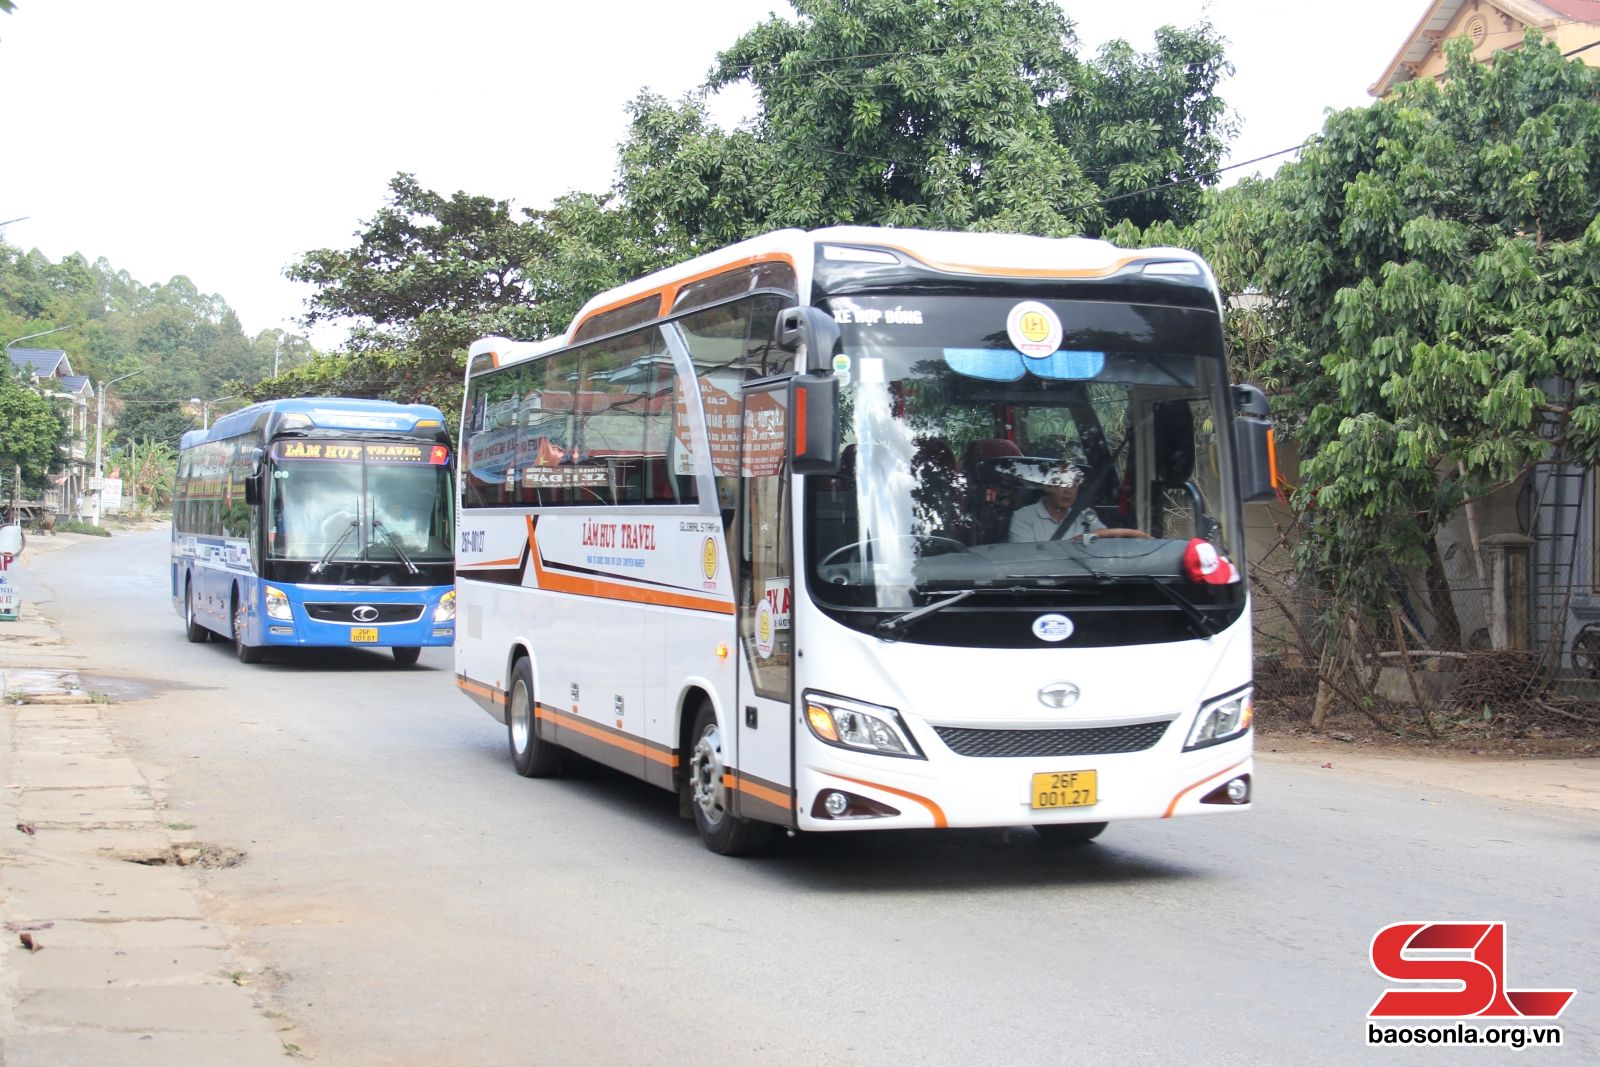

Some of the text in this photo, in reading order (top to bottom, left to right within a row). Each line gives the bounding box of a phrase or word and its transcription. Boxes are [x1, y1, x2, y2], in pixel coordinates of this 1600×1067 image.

[832, 309, 852, 324] XE
[284, 441, 422, 459] LÂM HUY TRAVEL
[582, 516, 656, 551] LÂM HUY TRAVEL
[680, 521, 700, 533] GLOBAL
[1051, 773, 1079, 789] 26F
[1039, 789, 1090, 807] 001.27
